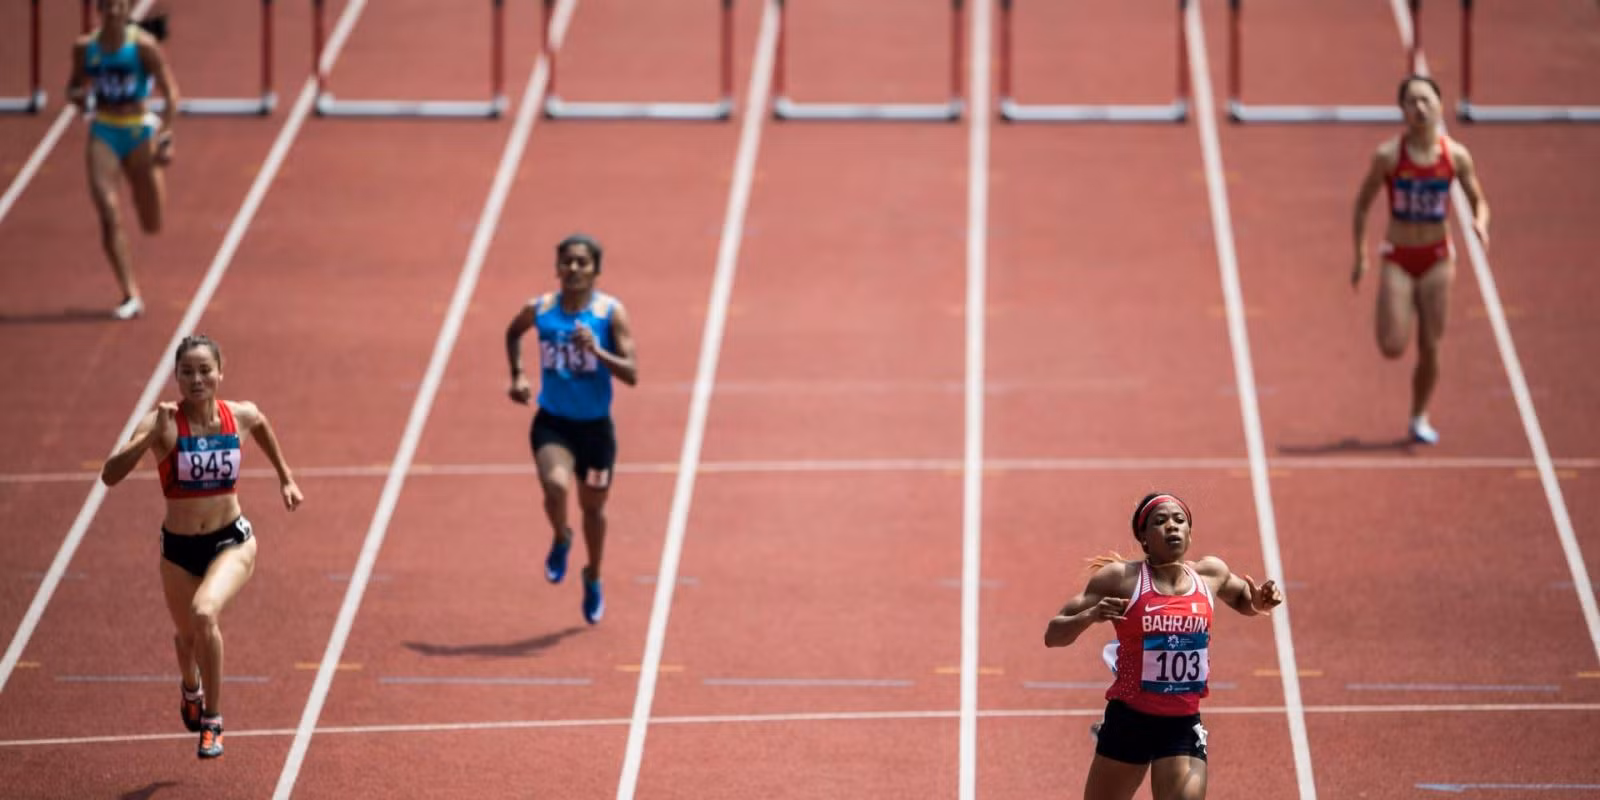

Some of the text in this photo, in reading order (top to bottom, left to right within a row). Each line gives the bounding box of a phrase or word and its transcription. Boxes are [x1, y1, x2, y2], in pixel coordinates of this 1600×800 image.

[190, 450, 233, 480] 845
[1142, 614, 1208, 634] BAHRAIN
[1156, 651, 1200, 682] 103
